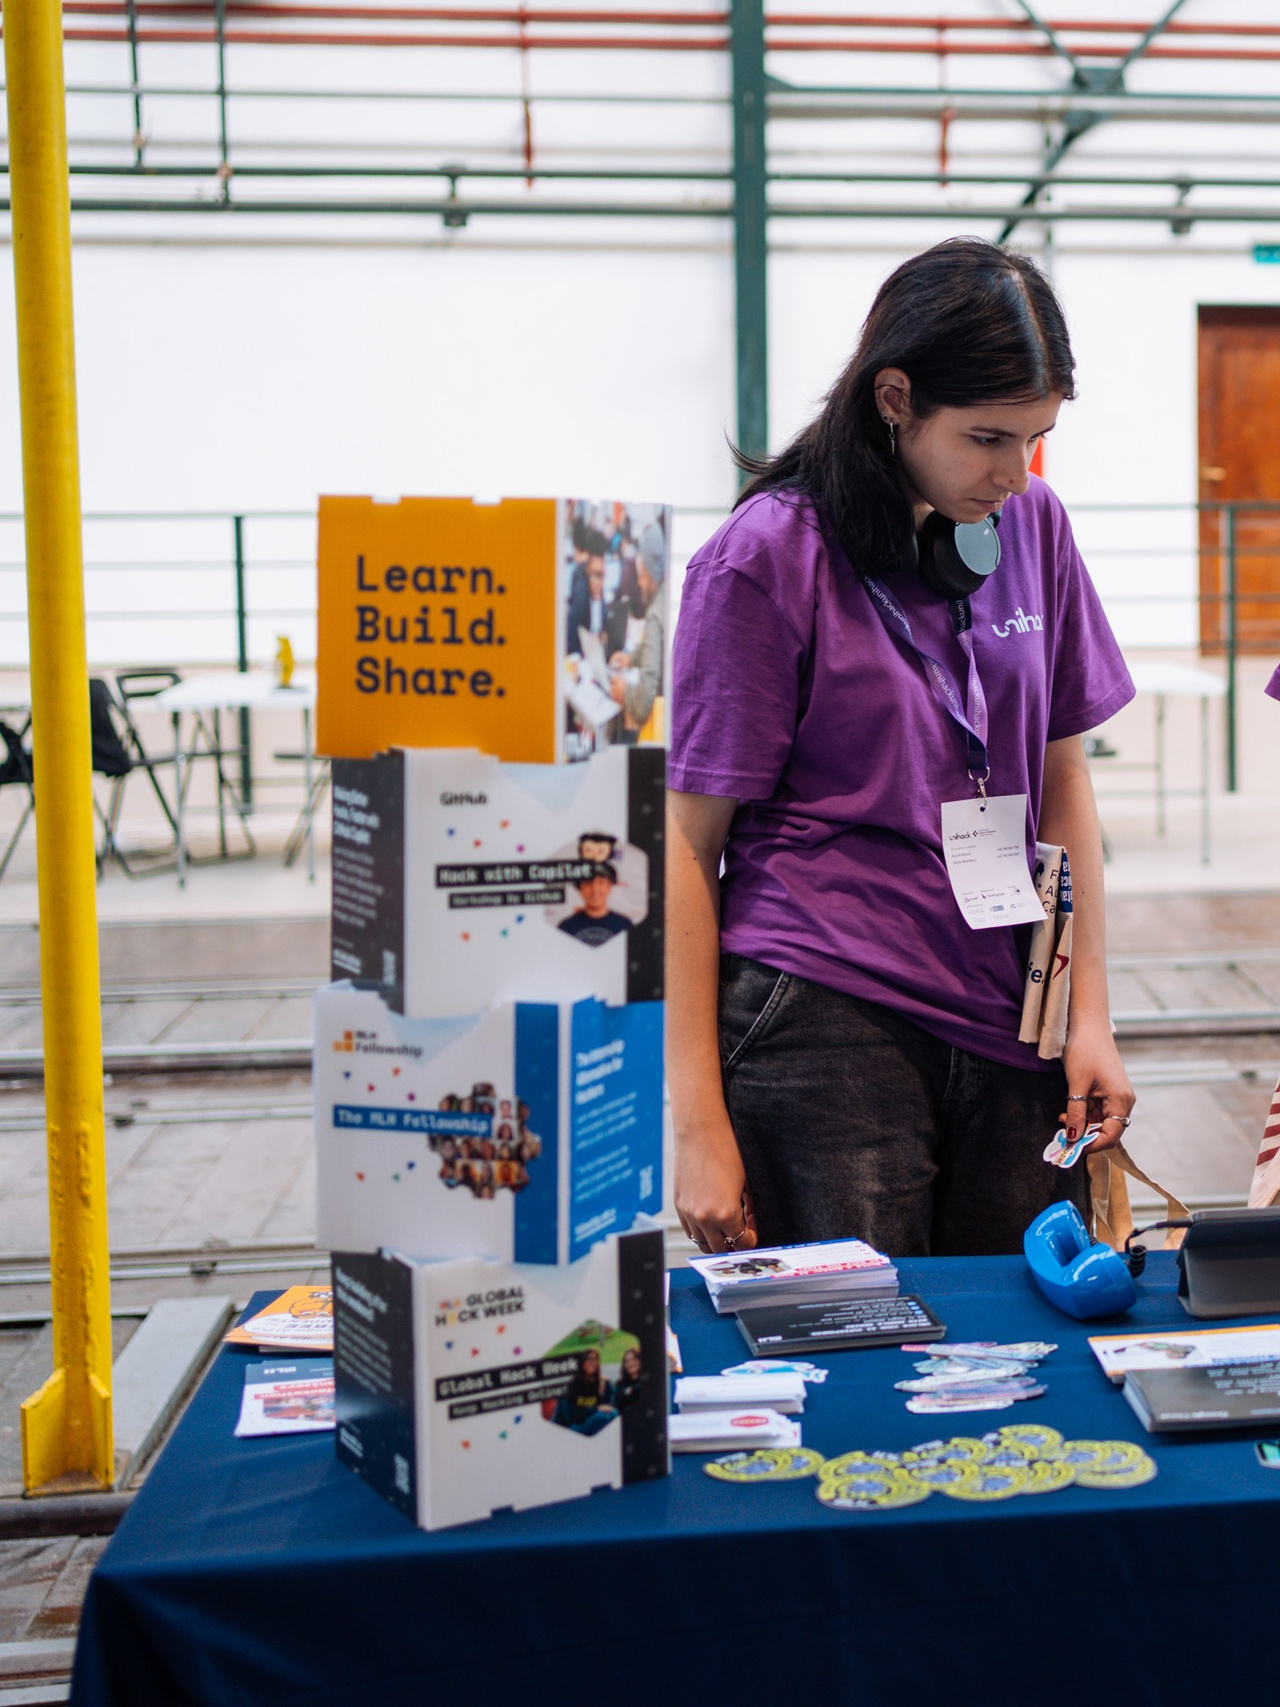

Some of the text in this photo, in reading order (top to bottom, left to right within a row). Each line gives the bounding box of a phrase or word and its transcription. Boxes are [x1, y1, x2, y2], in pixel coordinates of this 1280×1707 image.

[356, 555, 506, 594] Learn.
[356, 606, 506, 646] Build.
[355, 656, 506, 698] Share.
[439, 792, 487, 806] GitHub
[439, 863, 591, 882] Hack with Copilot
[356, 1043, 422, 1058] Fellowship
[338, 1110, 489, 1133] The MLH Fellowship
[466, 1286, 524, 1306] GLOBAL
[484, 1301, 525, 1318] WEEK
[263, 1366, 297, 1375] MLH
[439, 1358, 578, 1396] Global Hack Week
